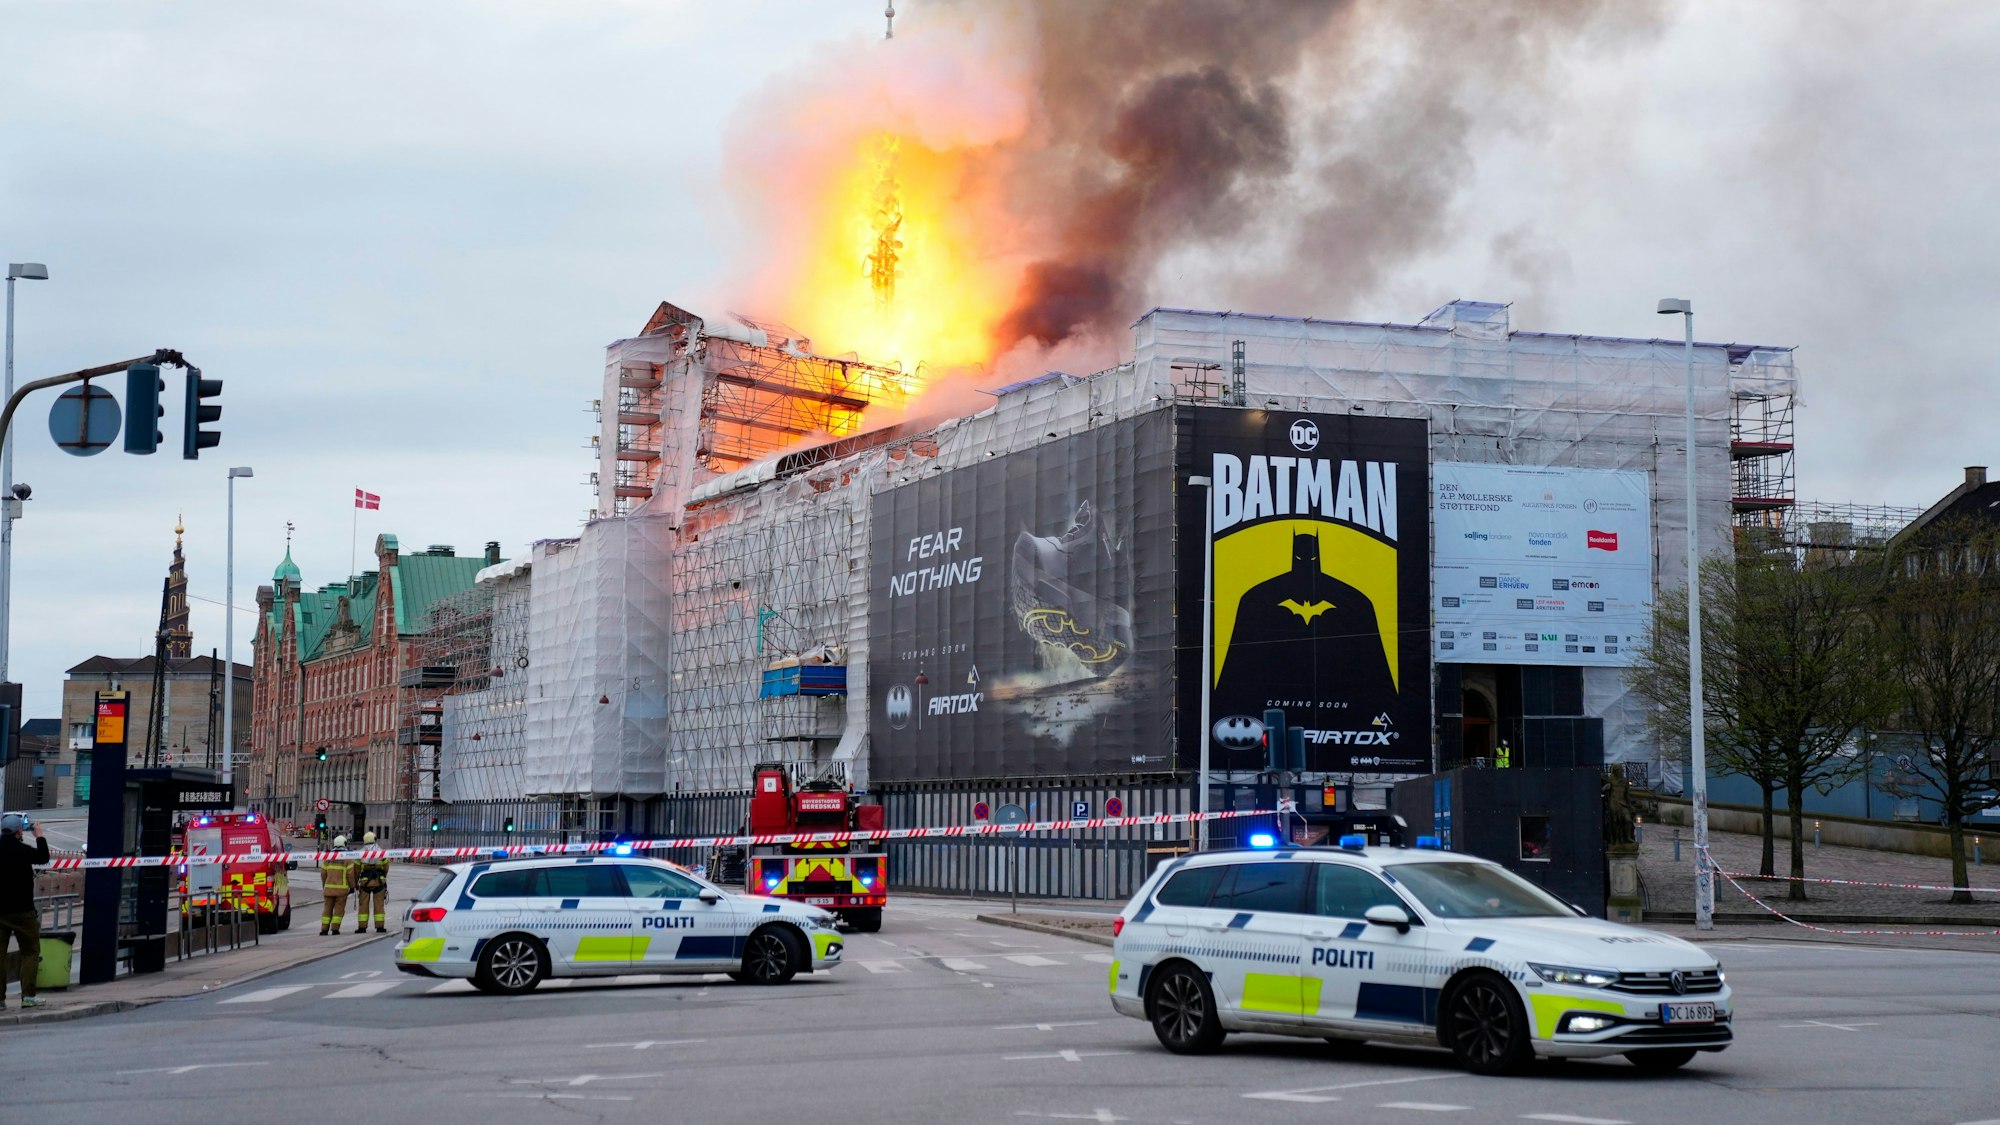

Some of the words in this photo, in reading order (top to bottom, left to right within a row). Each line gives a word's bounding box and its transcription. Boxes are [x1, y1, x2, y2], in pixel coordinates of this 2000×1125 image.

[1292, 426, 1318, 446] DC
[1212, 452, 1398, 542] BATMAN
[1458, 493, 1513, 502] MØLLERSKE
[1440, 502, 1500, 512] STØTTEFOND
[908, 527, 963, 562] FEAR
[1464, 532, 1488, 541] salling
[1489, 532, 1512, 540] fondene
[889, 557, 983, 598] NOTHING
[902, 648, 936, 660] COMING
[942, 644, 966, 654] SOON
[642, 916, 694, 929] POLITI
[1312, 948, 1374, 969] POLITI
[1670, 1004, 1681, 1019] DC
[1685, 1004, 1695, 1019] 16
[1697, 1006, 1713, 1019] 893
